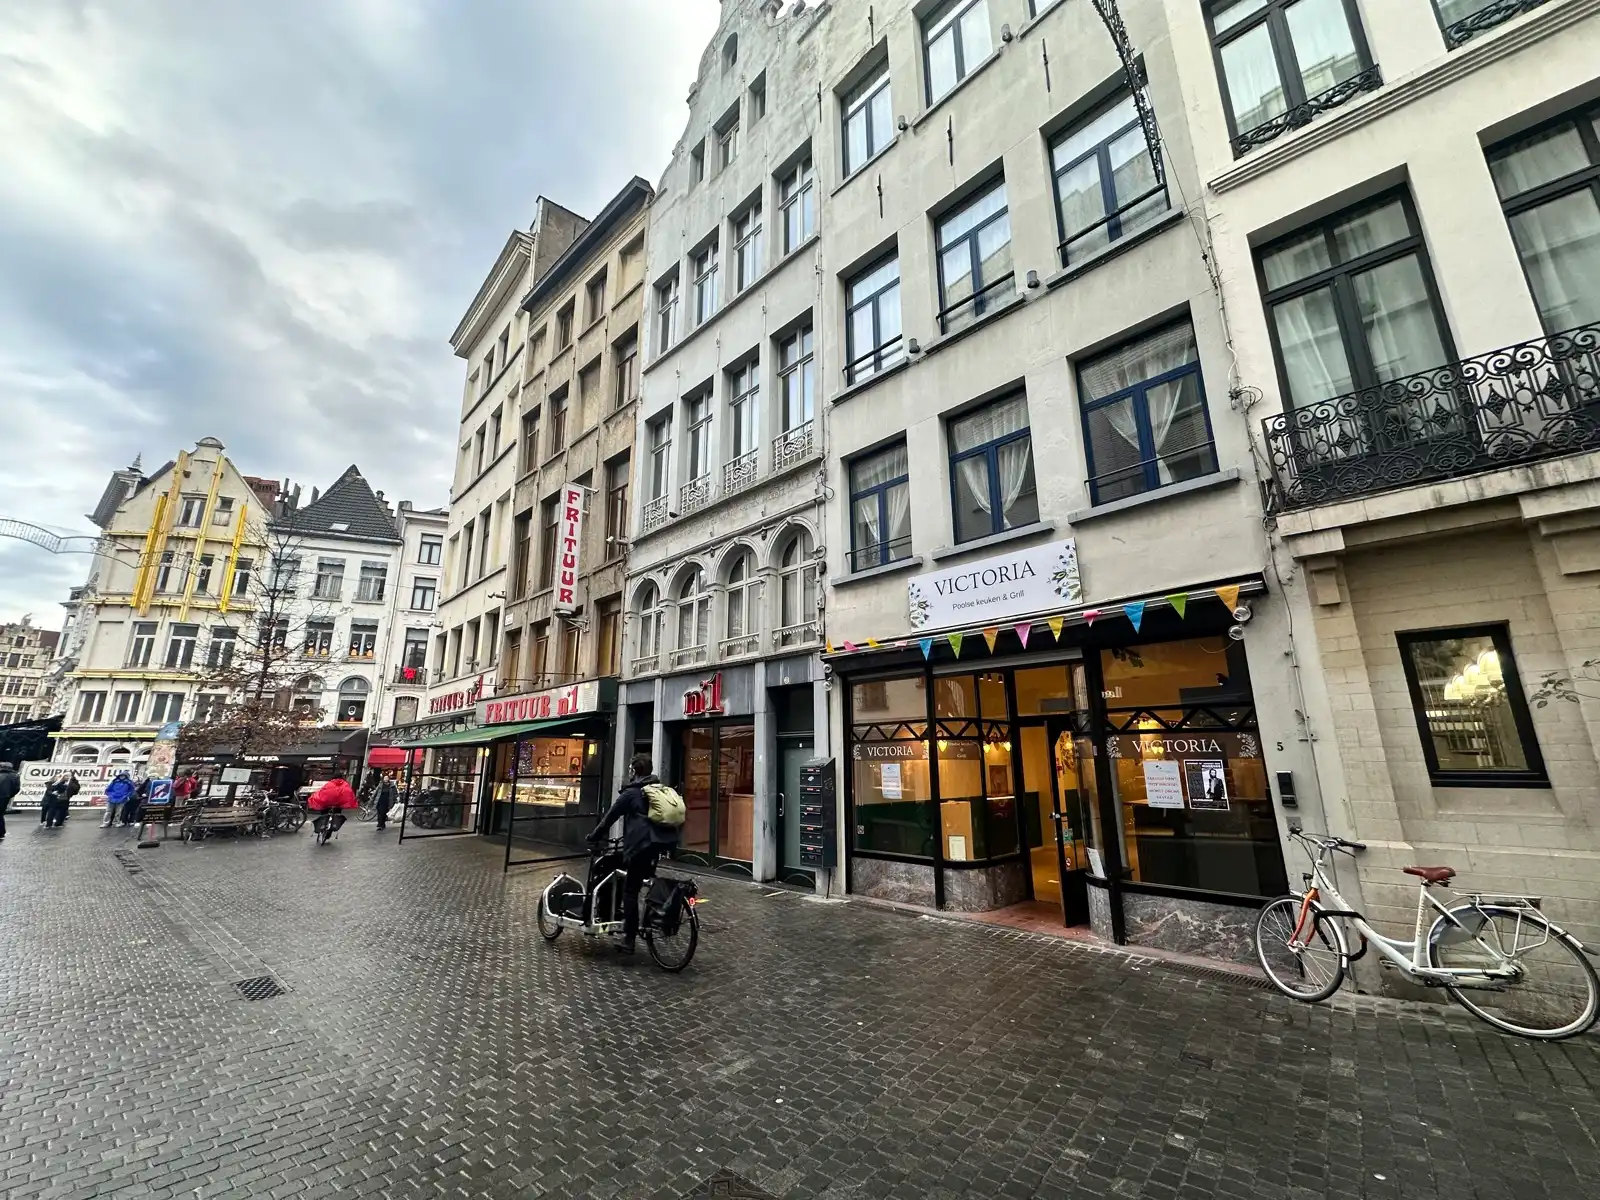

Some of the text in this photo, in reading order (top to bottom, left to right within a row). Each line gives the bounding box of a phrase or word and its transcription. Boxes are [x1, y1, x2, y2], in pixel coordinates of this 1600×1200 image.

[559, 489, 581, 604] FRITUUR
[934, 560, 1037, 596] VICTORIA
[952, 589, 1025, 610] Poolse keuken & Grill
[484, 687, 552, 724] FRITUUR
[866, 745, 914, 757] VICTORIA
[1131, 738, 1223, 755] VICTORIA
[1276, 741, 1284, 752] 5
